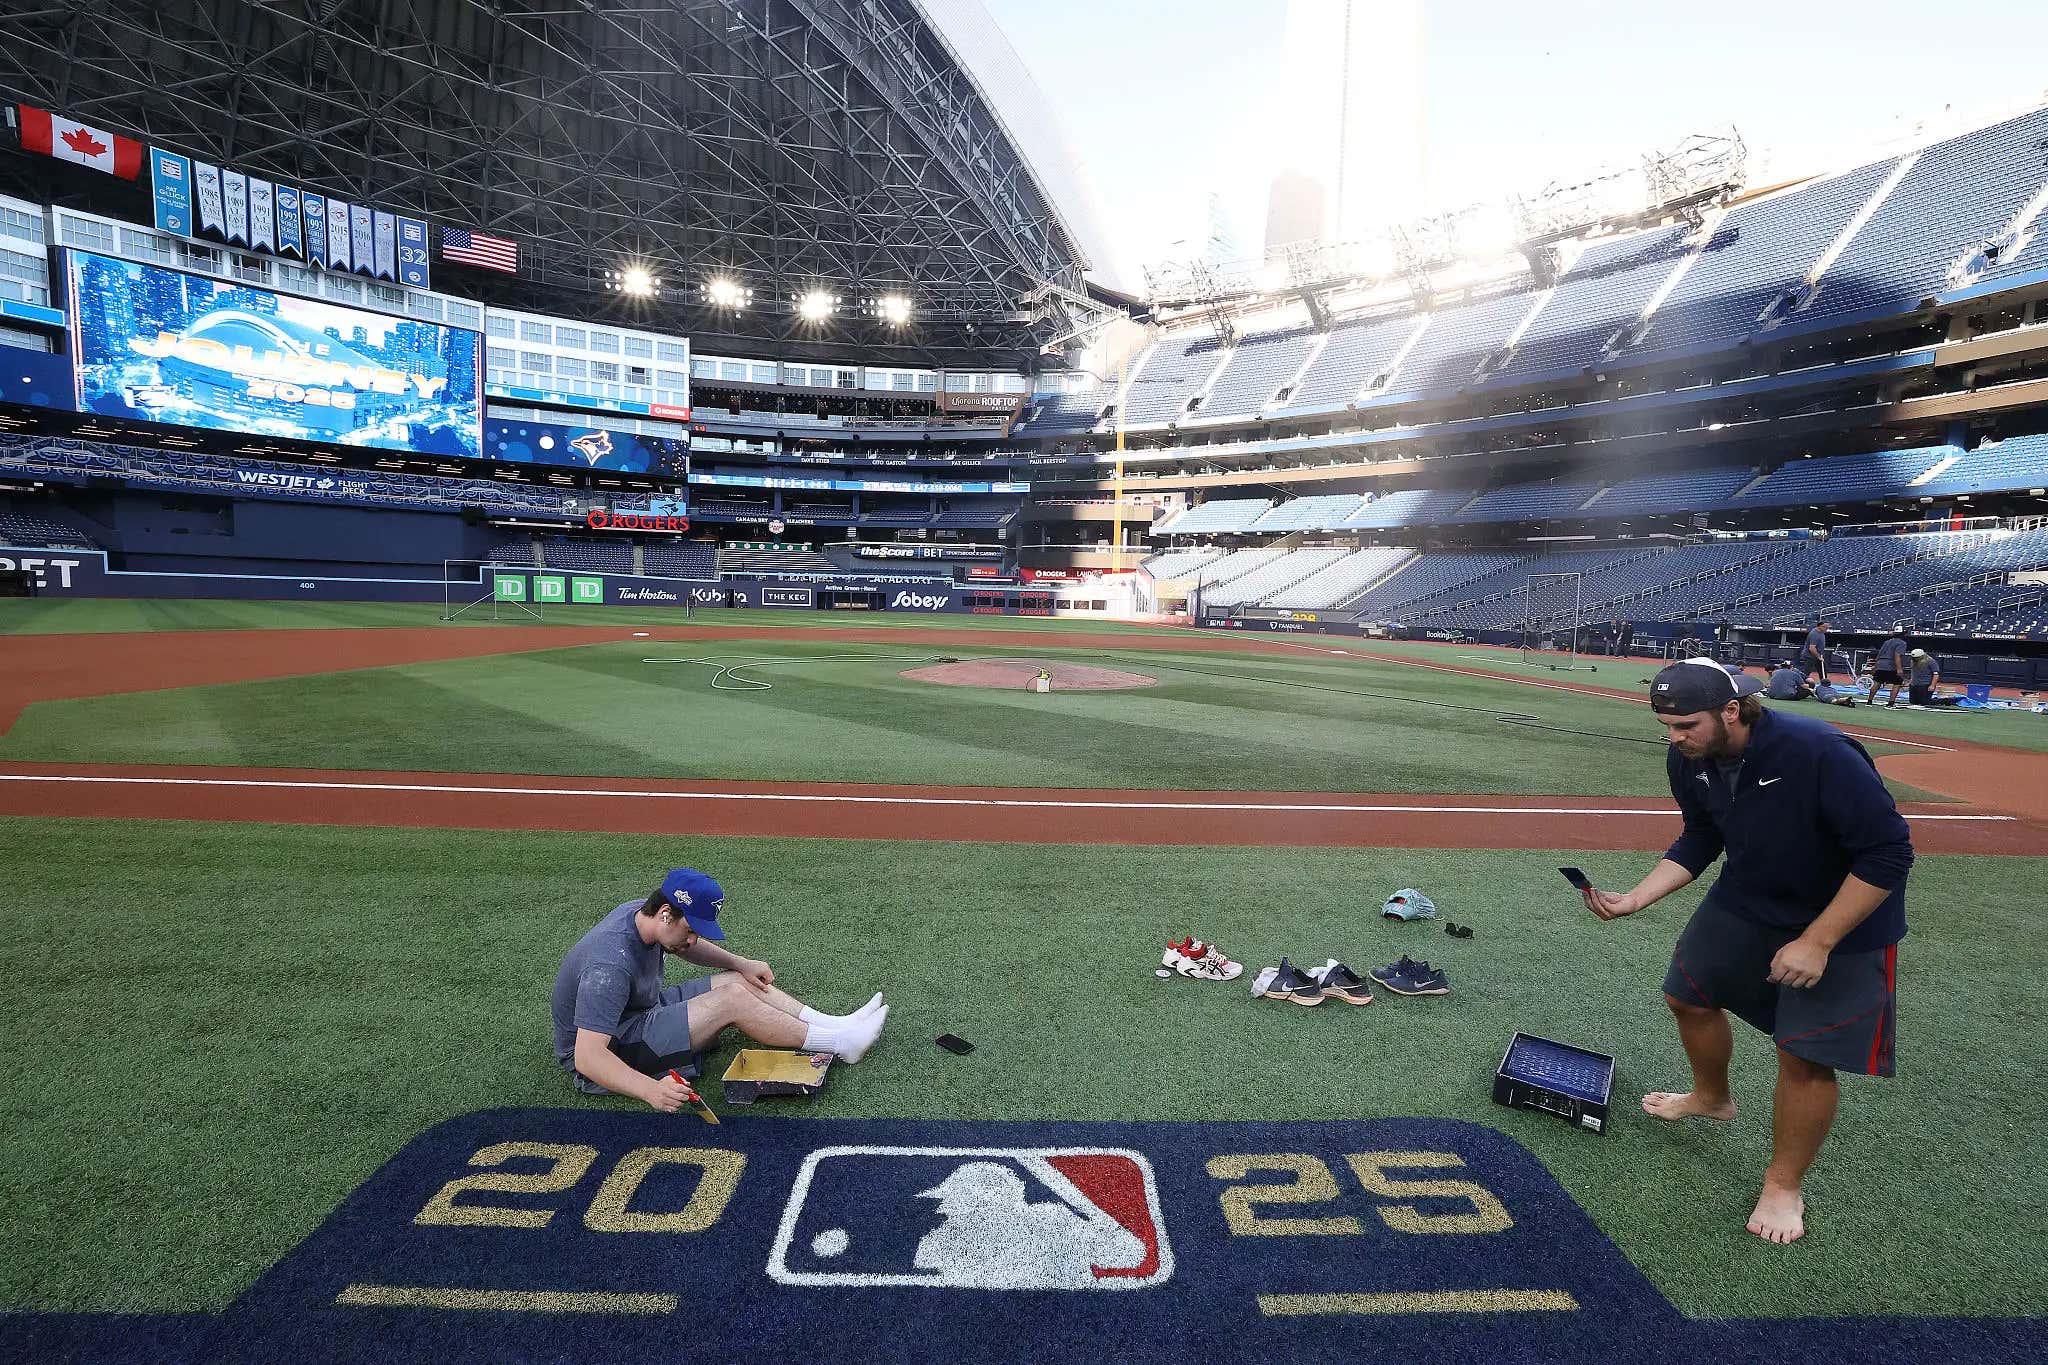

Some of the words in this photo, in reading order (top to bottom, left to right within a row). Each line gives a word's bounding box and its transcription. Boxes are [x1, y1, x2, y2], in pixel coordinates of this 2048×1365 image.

[200, 187, 219, 200] 1985
[253, 203, 270, 217] 1991
[280, 210, 297, 222] 1992
[307, 218, 323, 230] 1993
[330, 223, 348, 236] 2015
[401, 246, 427, 267] 32
[246, 380, 356, 410] 2025
[952, 396, 980, 406] Corona
[981, 397, 1019, 406] ROOFTOP
[237, 471, 315, 488] WESTJET
[338, 480, 369, 489] FLIGHT
[612, 513, 689, 532] ROGERS
[861, 546, 914, 557] theScore
[924, 548, 943, 557] BET
[0, 557, 80, 588] ET
[497, 579, 523, 596] TD
[537, 580, 561, 597] TD
[575, 581, 600, 597] TD
[617, 587, 638, 600] Tim
[638, 587, 678, 601] Hortons
[692, 588, 748, 602] Kuba
[788, 593, 806, 601] KEG
[892, 590, 949, 610] Sobeys
[413, 1141, 748, 1233] 20
[1205, 1150, 1515, 1236] 25
